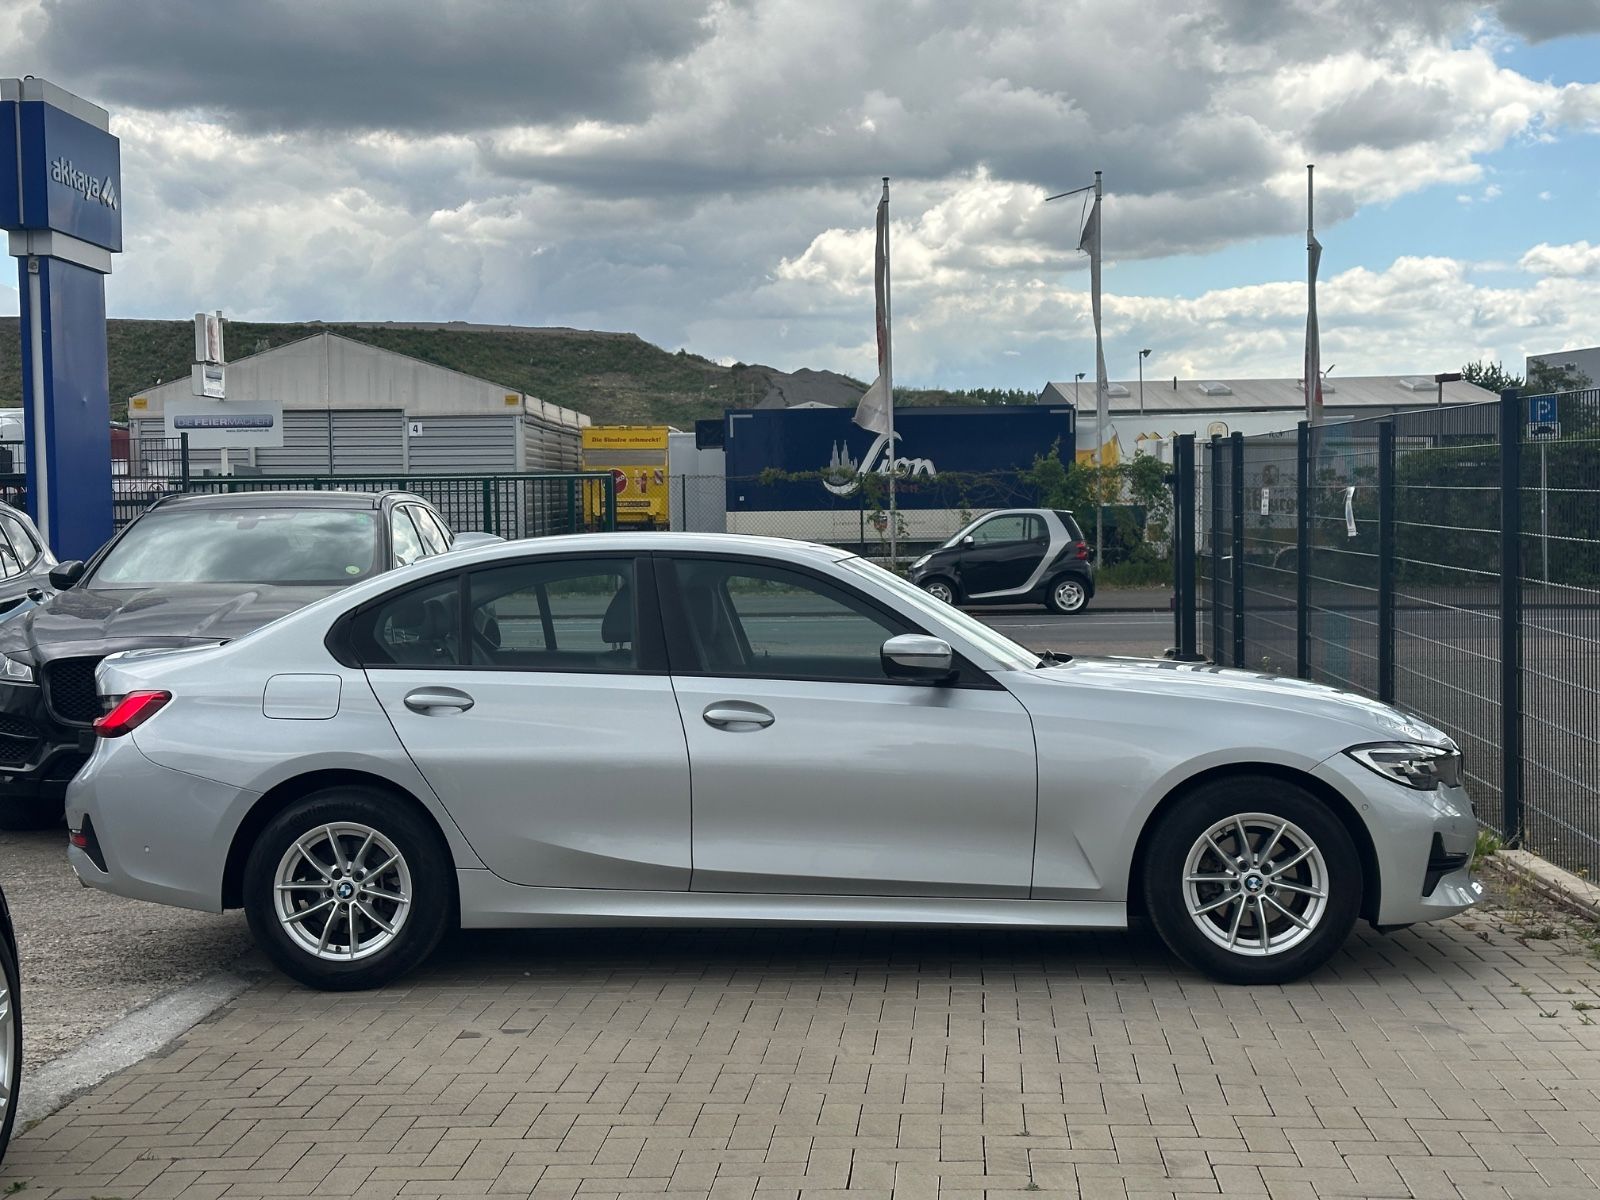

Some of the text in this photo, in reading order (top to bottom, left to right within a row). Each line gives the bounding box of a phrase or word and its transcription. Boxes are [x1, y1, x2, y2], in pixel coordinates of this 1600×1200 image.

[50, 157, 100, 200] akkaya
[1537, 400, 1551, 421] P
[195, 416, 270, 426] FEIERMACHER
[412, 424, 419, 433] 4
